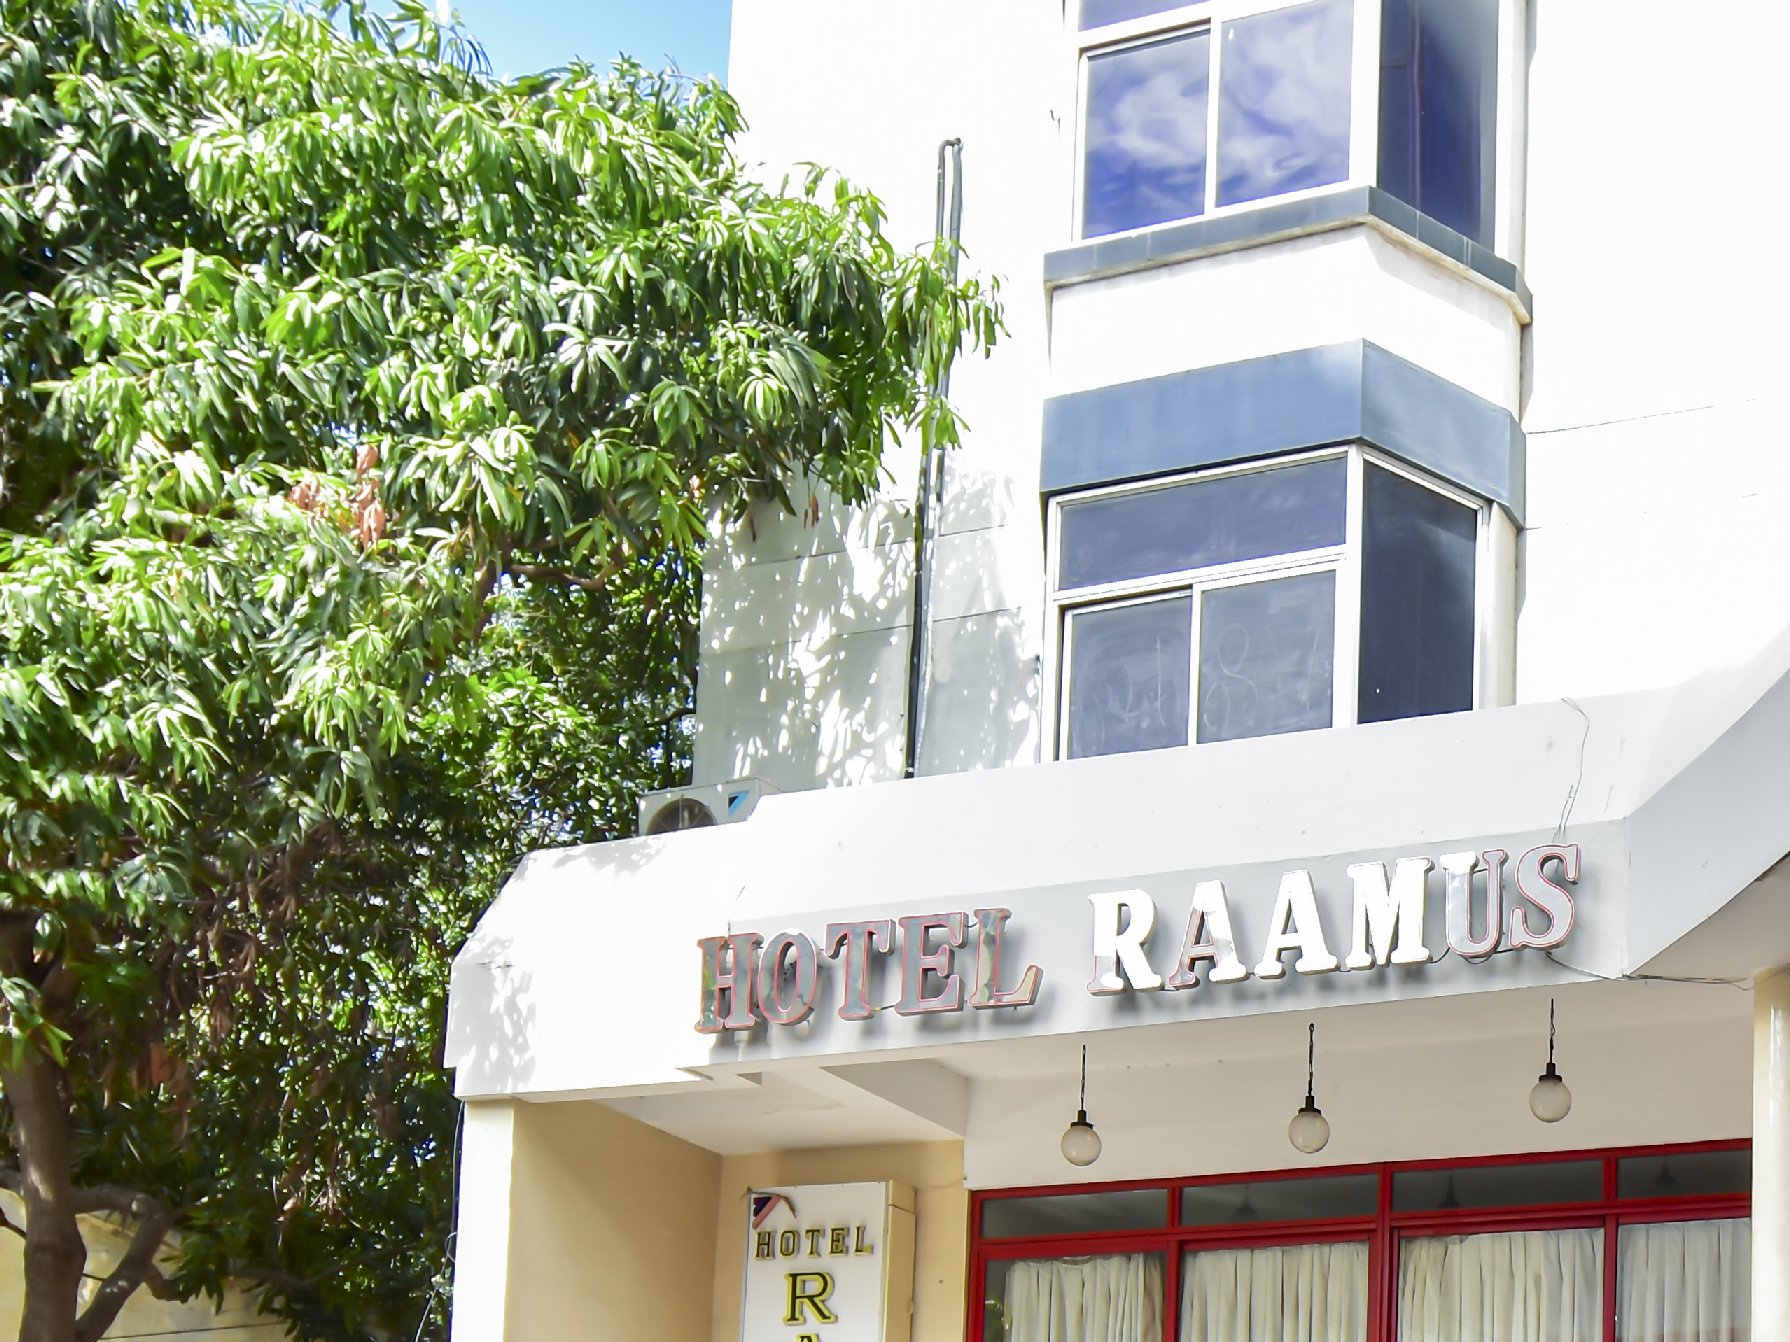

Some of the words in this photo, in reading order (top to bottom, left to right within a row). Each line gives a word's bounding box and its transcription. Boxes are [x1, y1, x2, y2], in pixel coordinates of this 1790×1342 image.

[694, 906, 1043, 1034] HOTEL
[1087, 842, 1582, 997] RAAMUS
[755, 1226, 874, 1261] HOTEL
